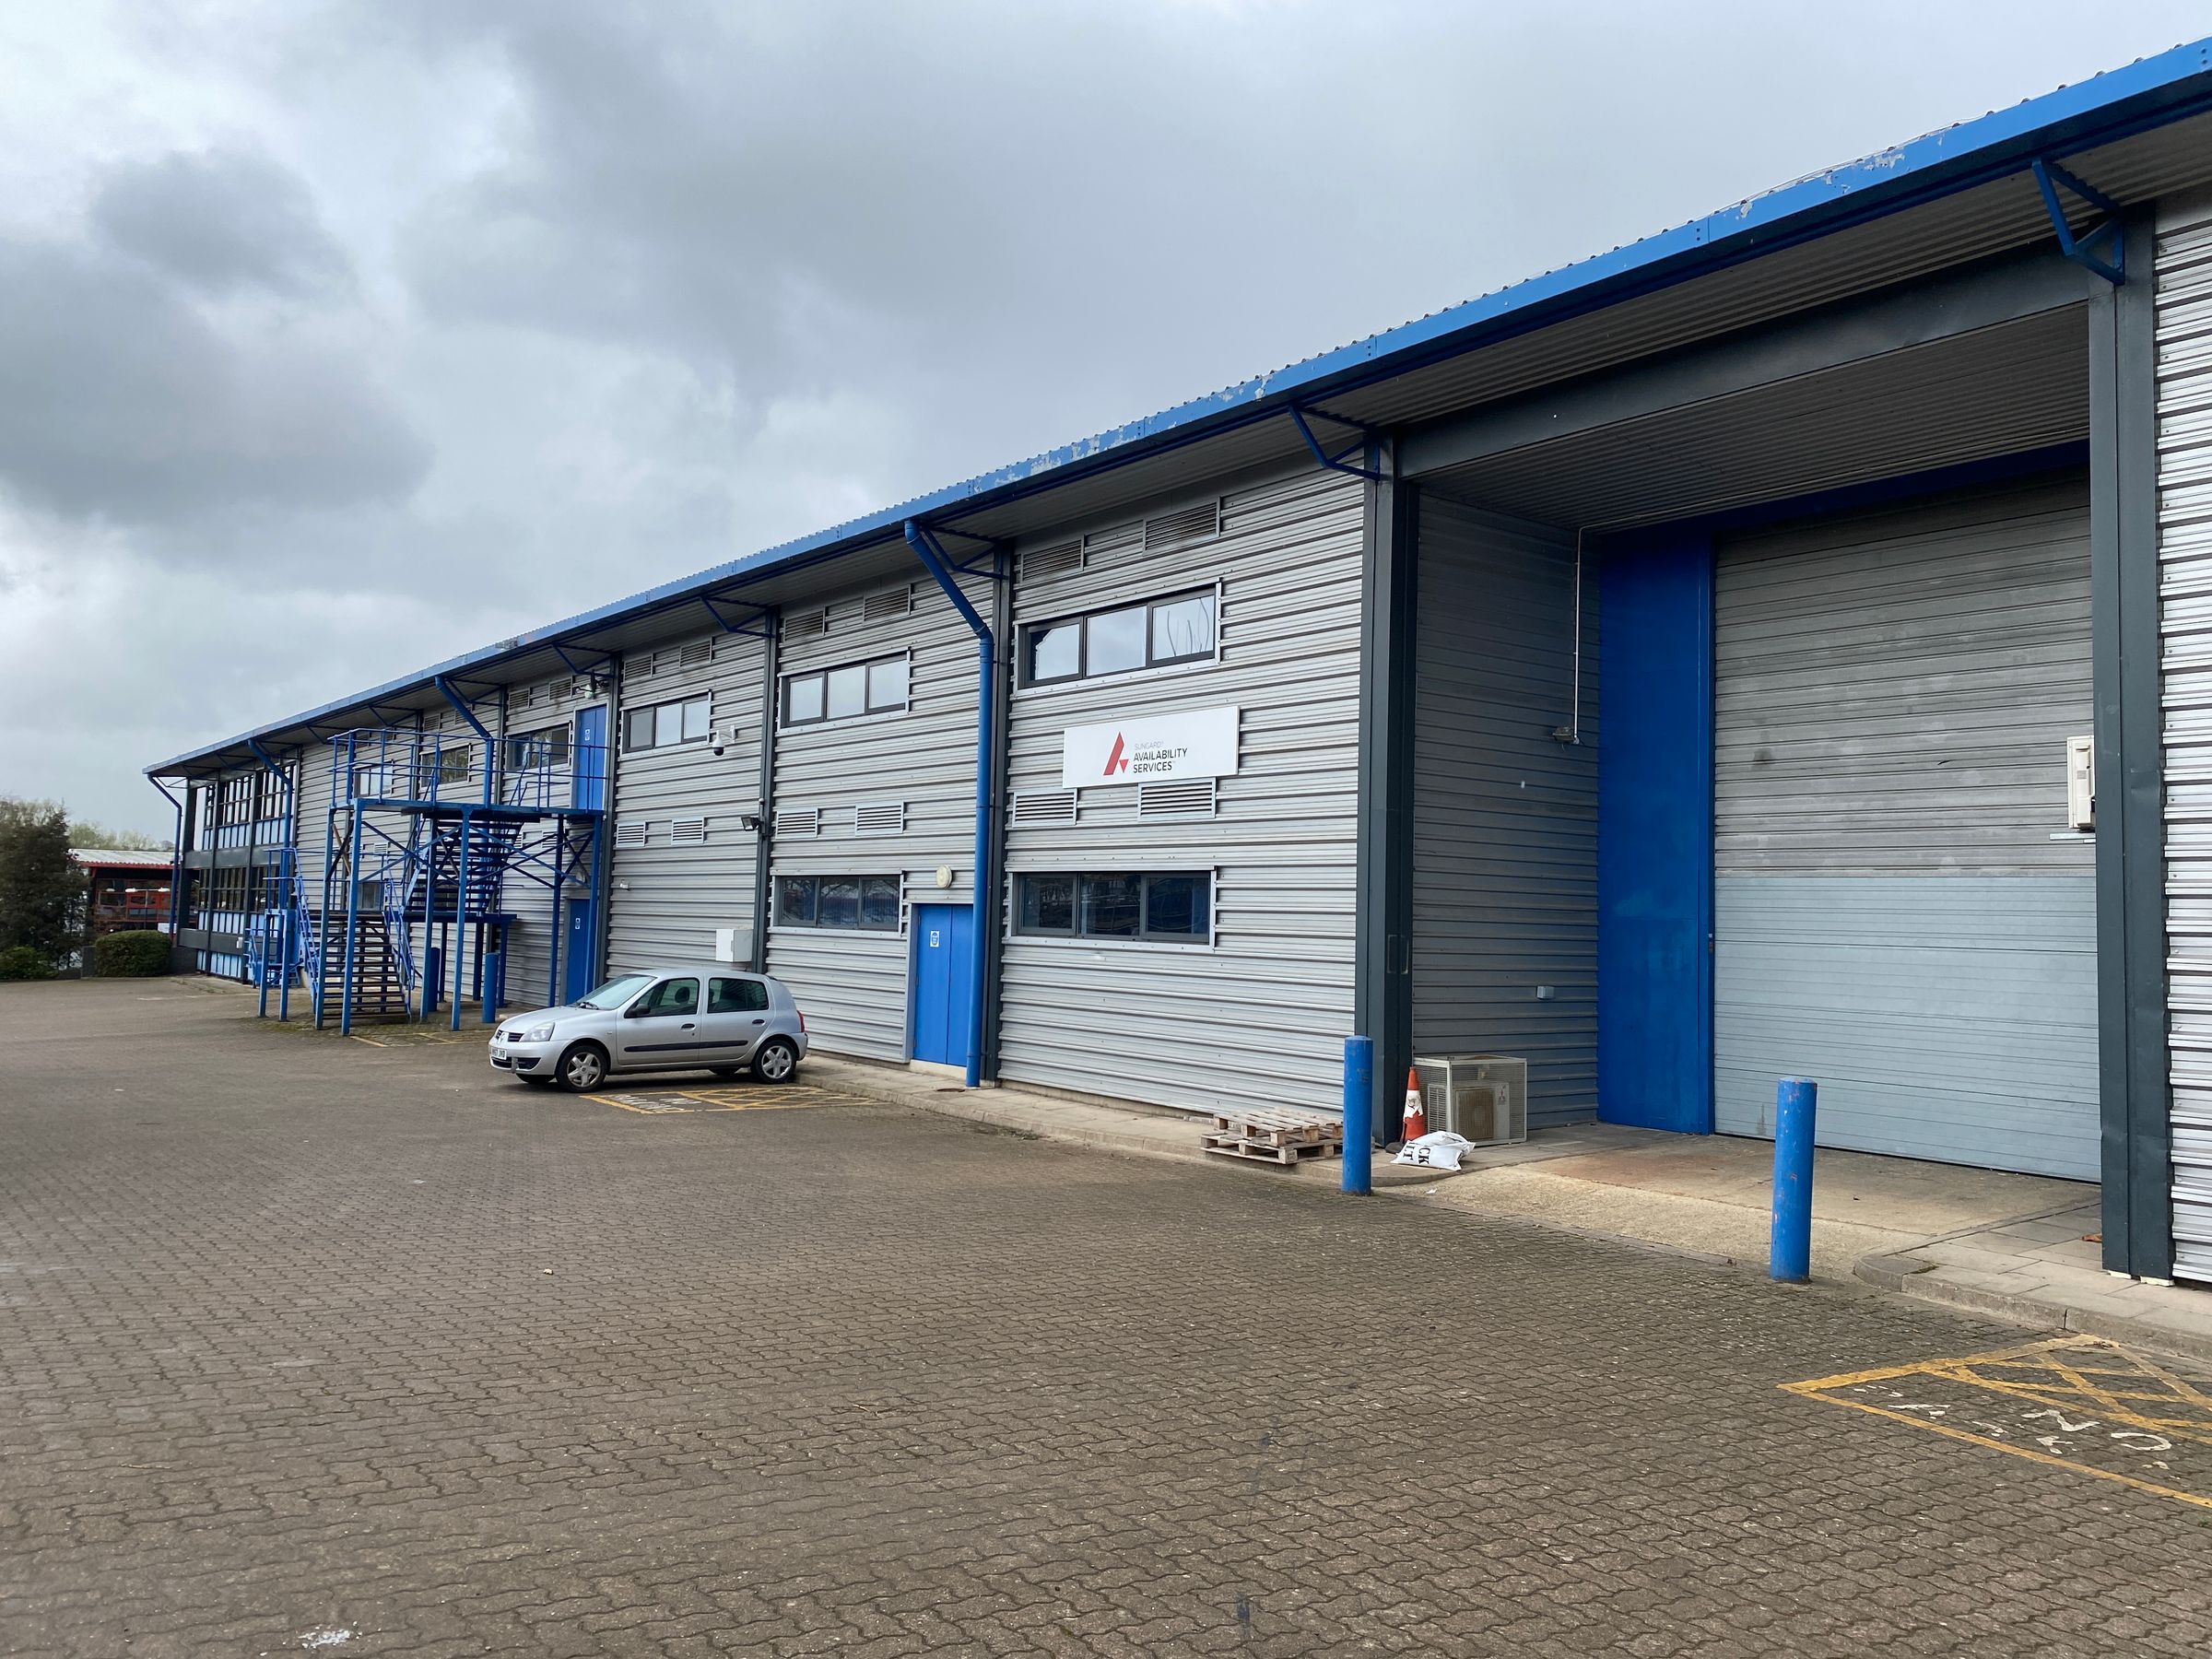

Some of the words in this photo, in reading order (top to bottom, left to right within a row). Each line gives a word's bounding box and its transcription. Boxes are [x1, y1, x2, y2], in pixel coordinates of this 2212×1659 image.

[1133, 747, 1187, 761] AVAILABILITY
[1133, 760, 1172, 773] SERVICES
[1418, 1145, 1431, 1165] CK
